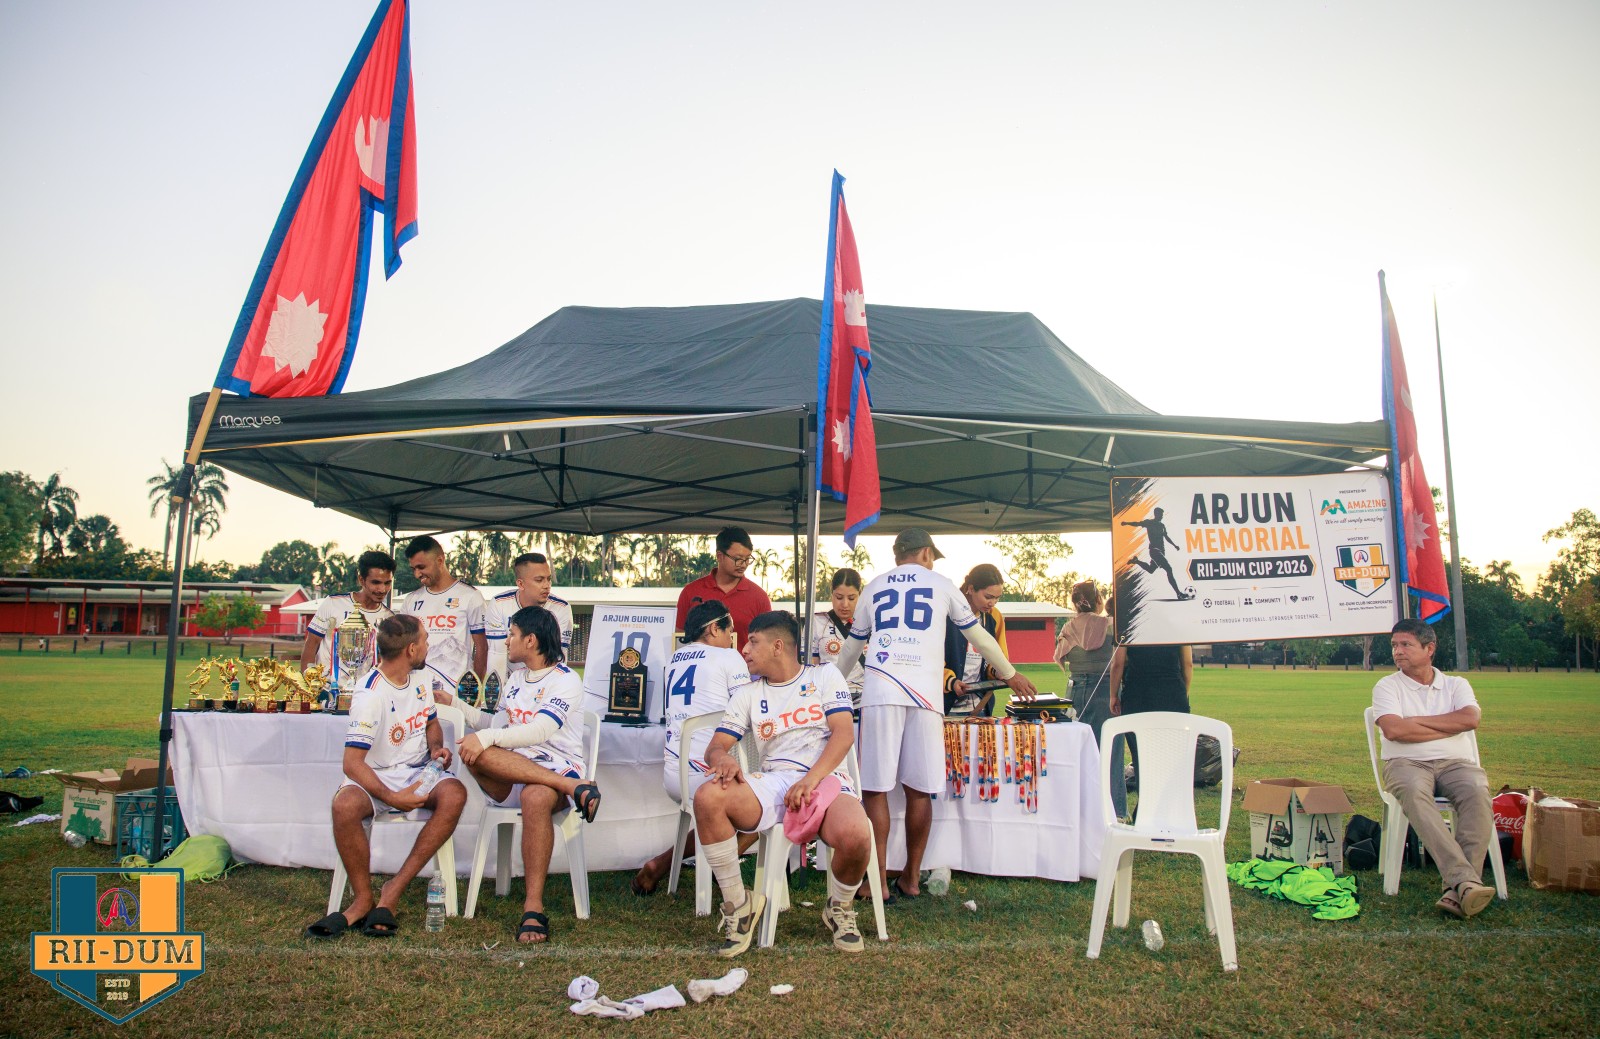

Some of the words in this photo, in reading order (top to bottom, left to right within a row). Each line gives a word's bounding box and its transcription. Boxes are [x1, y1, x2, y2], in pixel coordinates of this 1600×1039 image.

[219, 415, 281, 428] Marquee
[1190, 492, 1296, 525] ARJUN
[1184, 526, 1310, 553] MEMORIAL
[1196, 562, 1246, 578] RII-DUM
[1248, 560, 1273, 576] CUP
[1276, 560, 1308, 575] 2026
[1338, 568, 1387, 578] RII-DUM
[888, 574, 916, 583] NJK
[414, 600, 424, 611] 17
[873, 588, 933, 632] 26
[427, 615, 458, 628] TCS
[602, 615, 629, 623] ARJUN
[612, 631, 651, 664] 10
[671, 650, 706, 664] ABIGAIL
[666, 664, 697, 709] 14
[550, 697, 570, 712] 2026
[760, 700, 768, 713] 9
[779, 704, 823, 728] TCS
